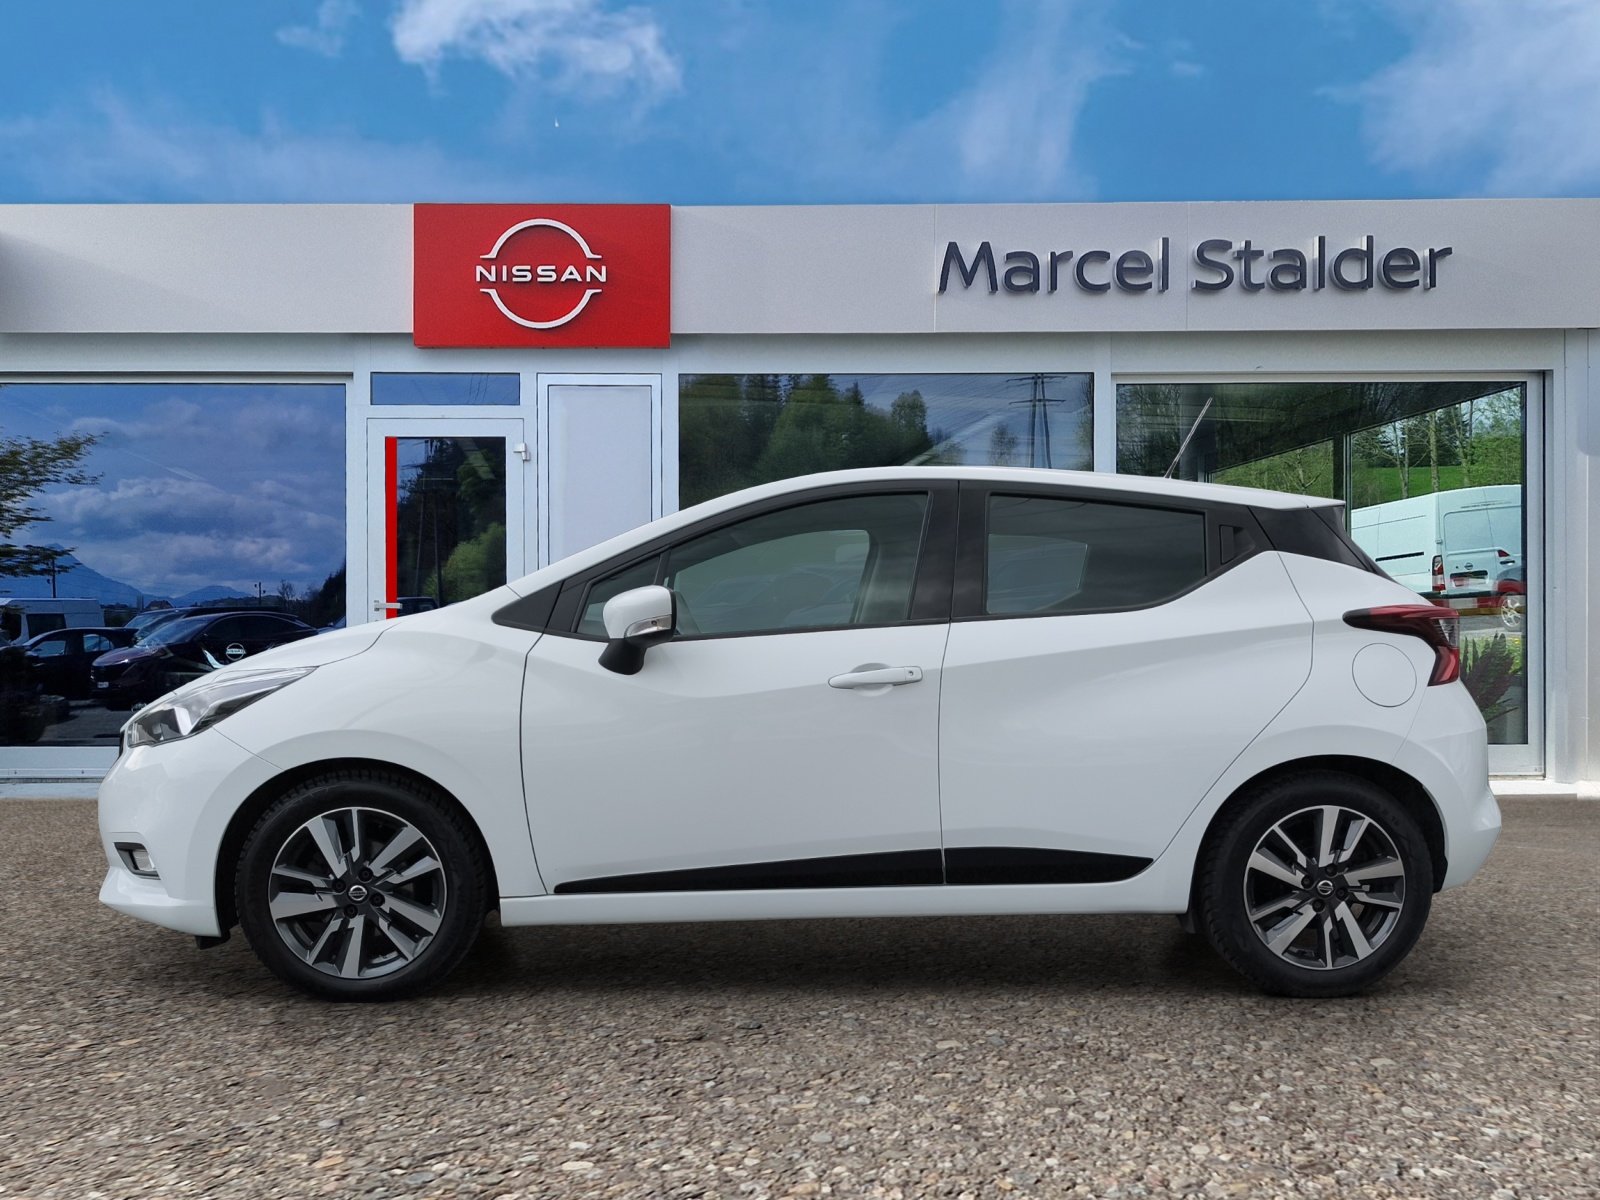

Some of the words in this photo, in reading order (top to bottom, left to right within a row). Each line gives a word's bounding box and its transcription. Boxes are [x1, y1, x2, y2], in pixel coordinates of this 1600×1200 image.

[475, 265, 607, 282] NISSAN
[938, 237, 1170, 294] Marcel
[1192, 235, 1453, 292] Stalder
